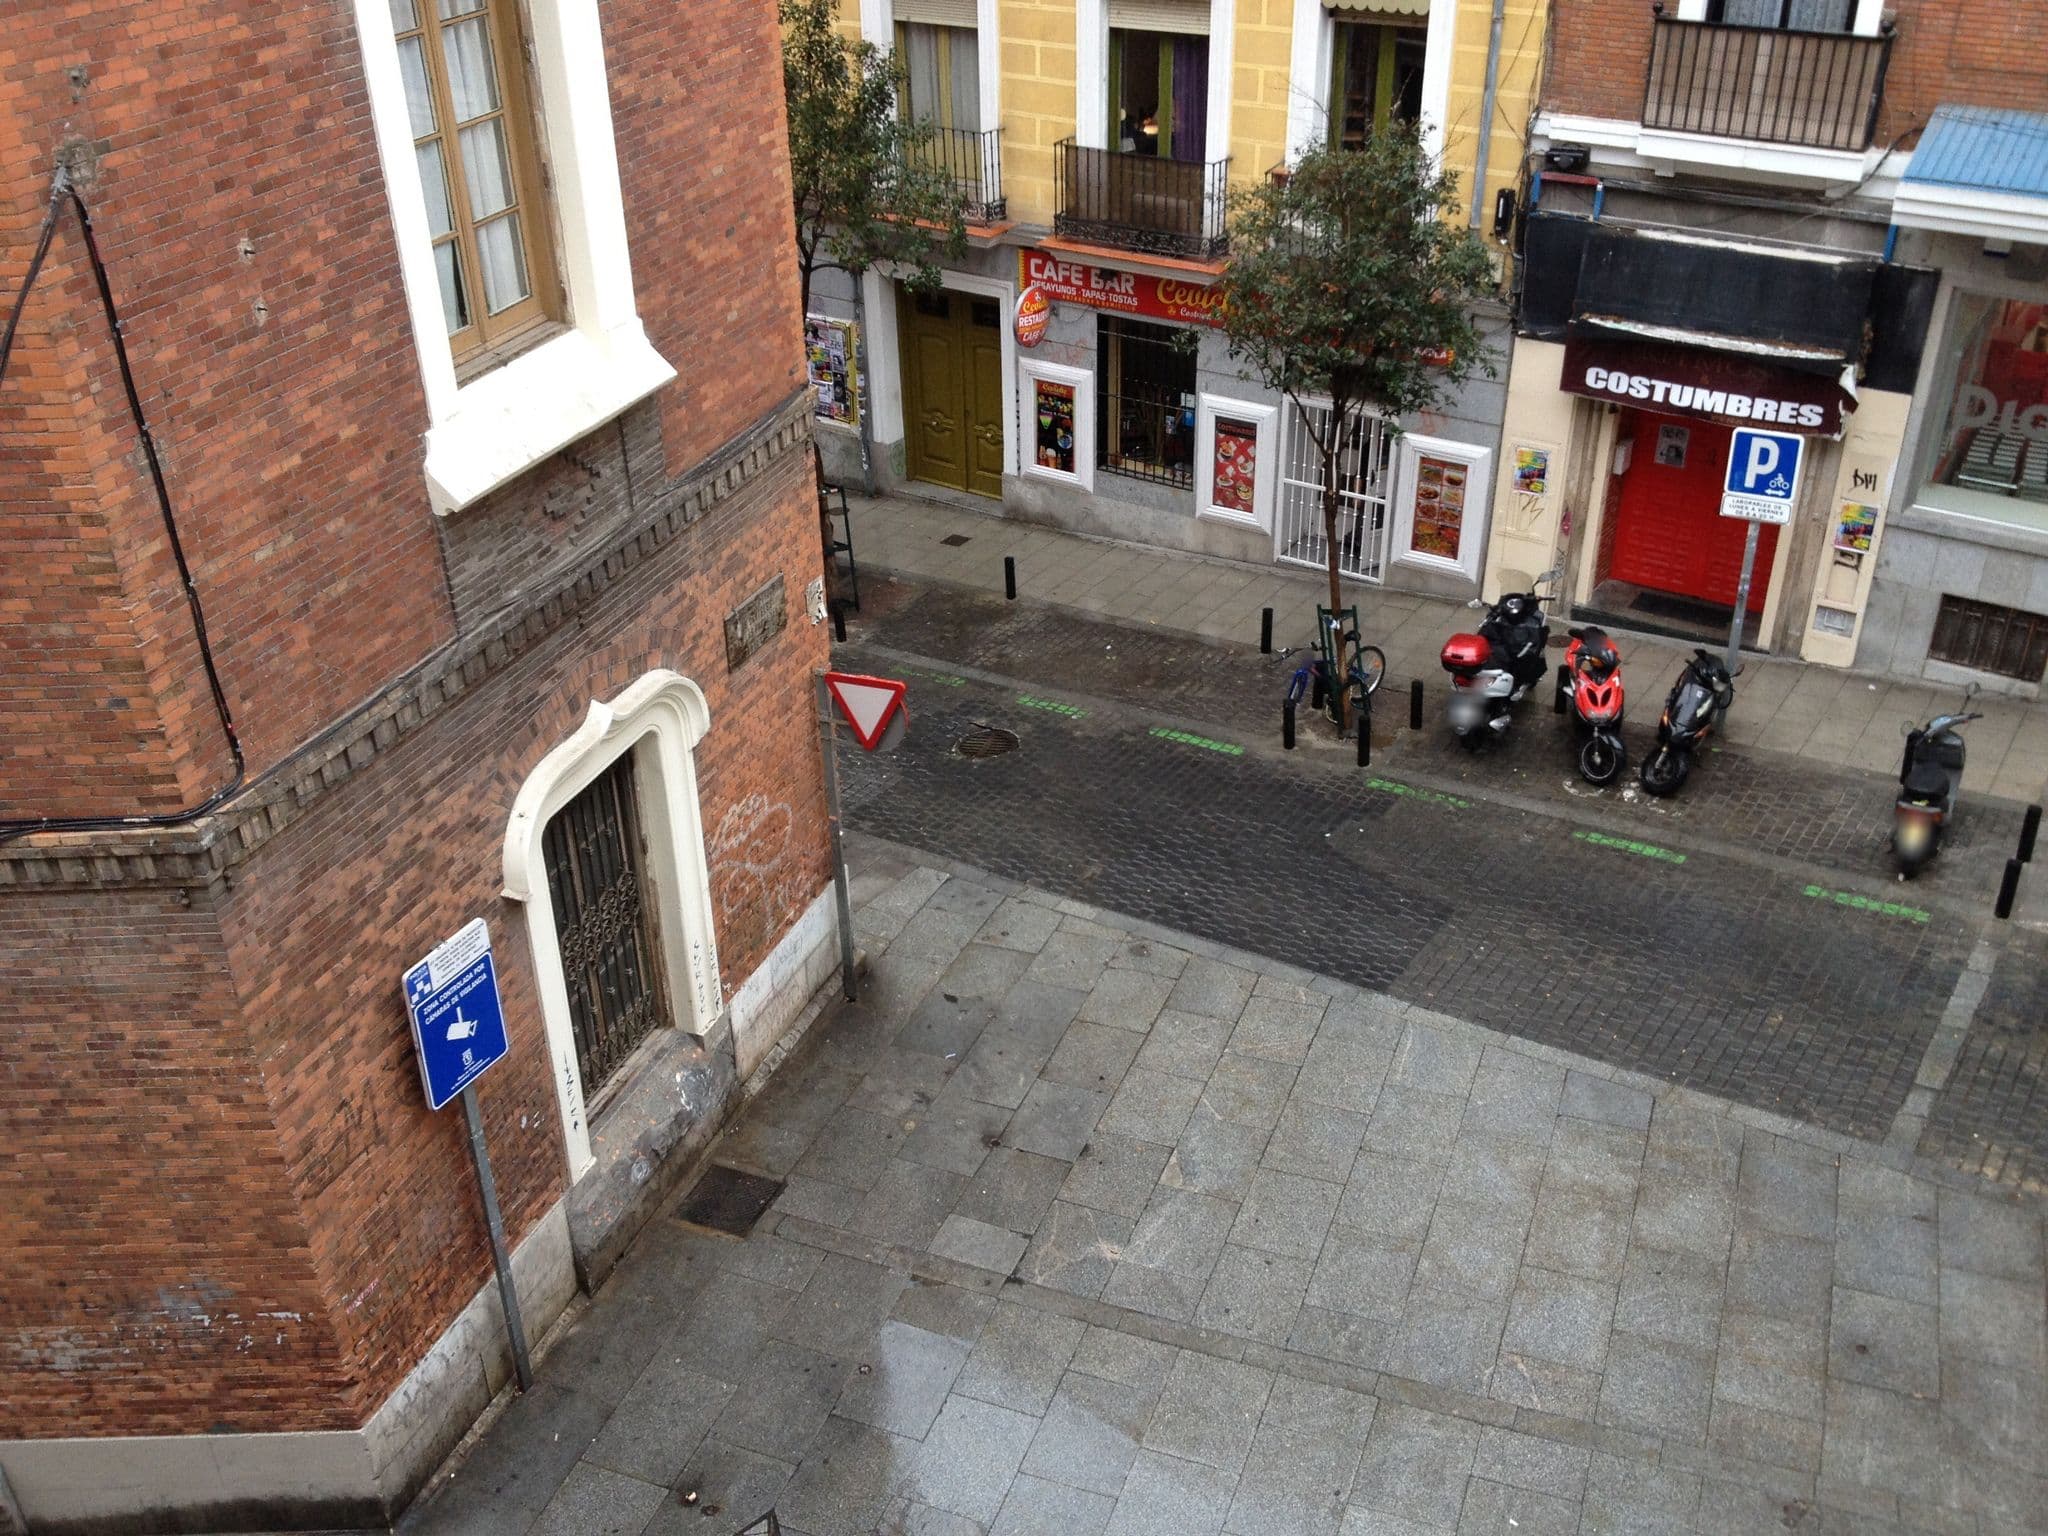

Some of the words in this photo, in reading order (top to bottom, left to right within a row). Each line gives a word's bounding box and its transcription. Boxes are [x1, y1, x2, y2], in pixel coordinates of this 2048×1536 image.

[1030, 258, 1083, 286] CAFE
[1090, 268, 1135, 295] BAR
[1108, 293, 1138, 306] TOSTAS
[1585, 367, 1824, 427] COSTUMBRES
[1744, 436, 1779, 488] P
[423, 999, 439, 1015] ZONA
[439, 972, 474, 1002] CONTROLADA
[473, 962, 486, 976] POR
[450, 994, 460, 1006] DE
[459, 973, 488, 998] VIGILANCIA
